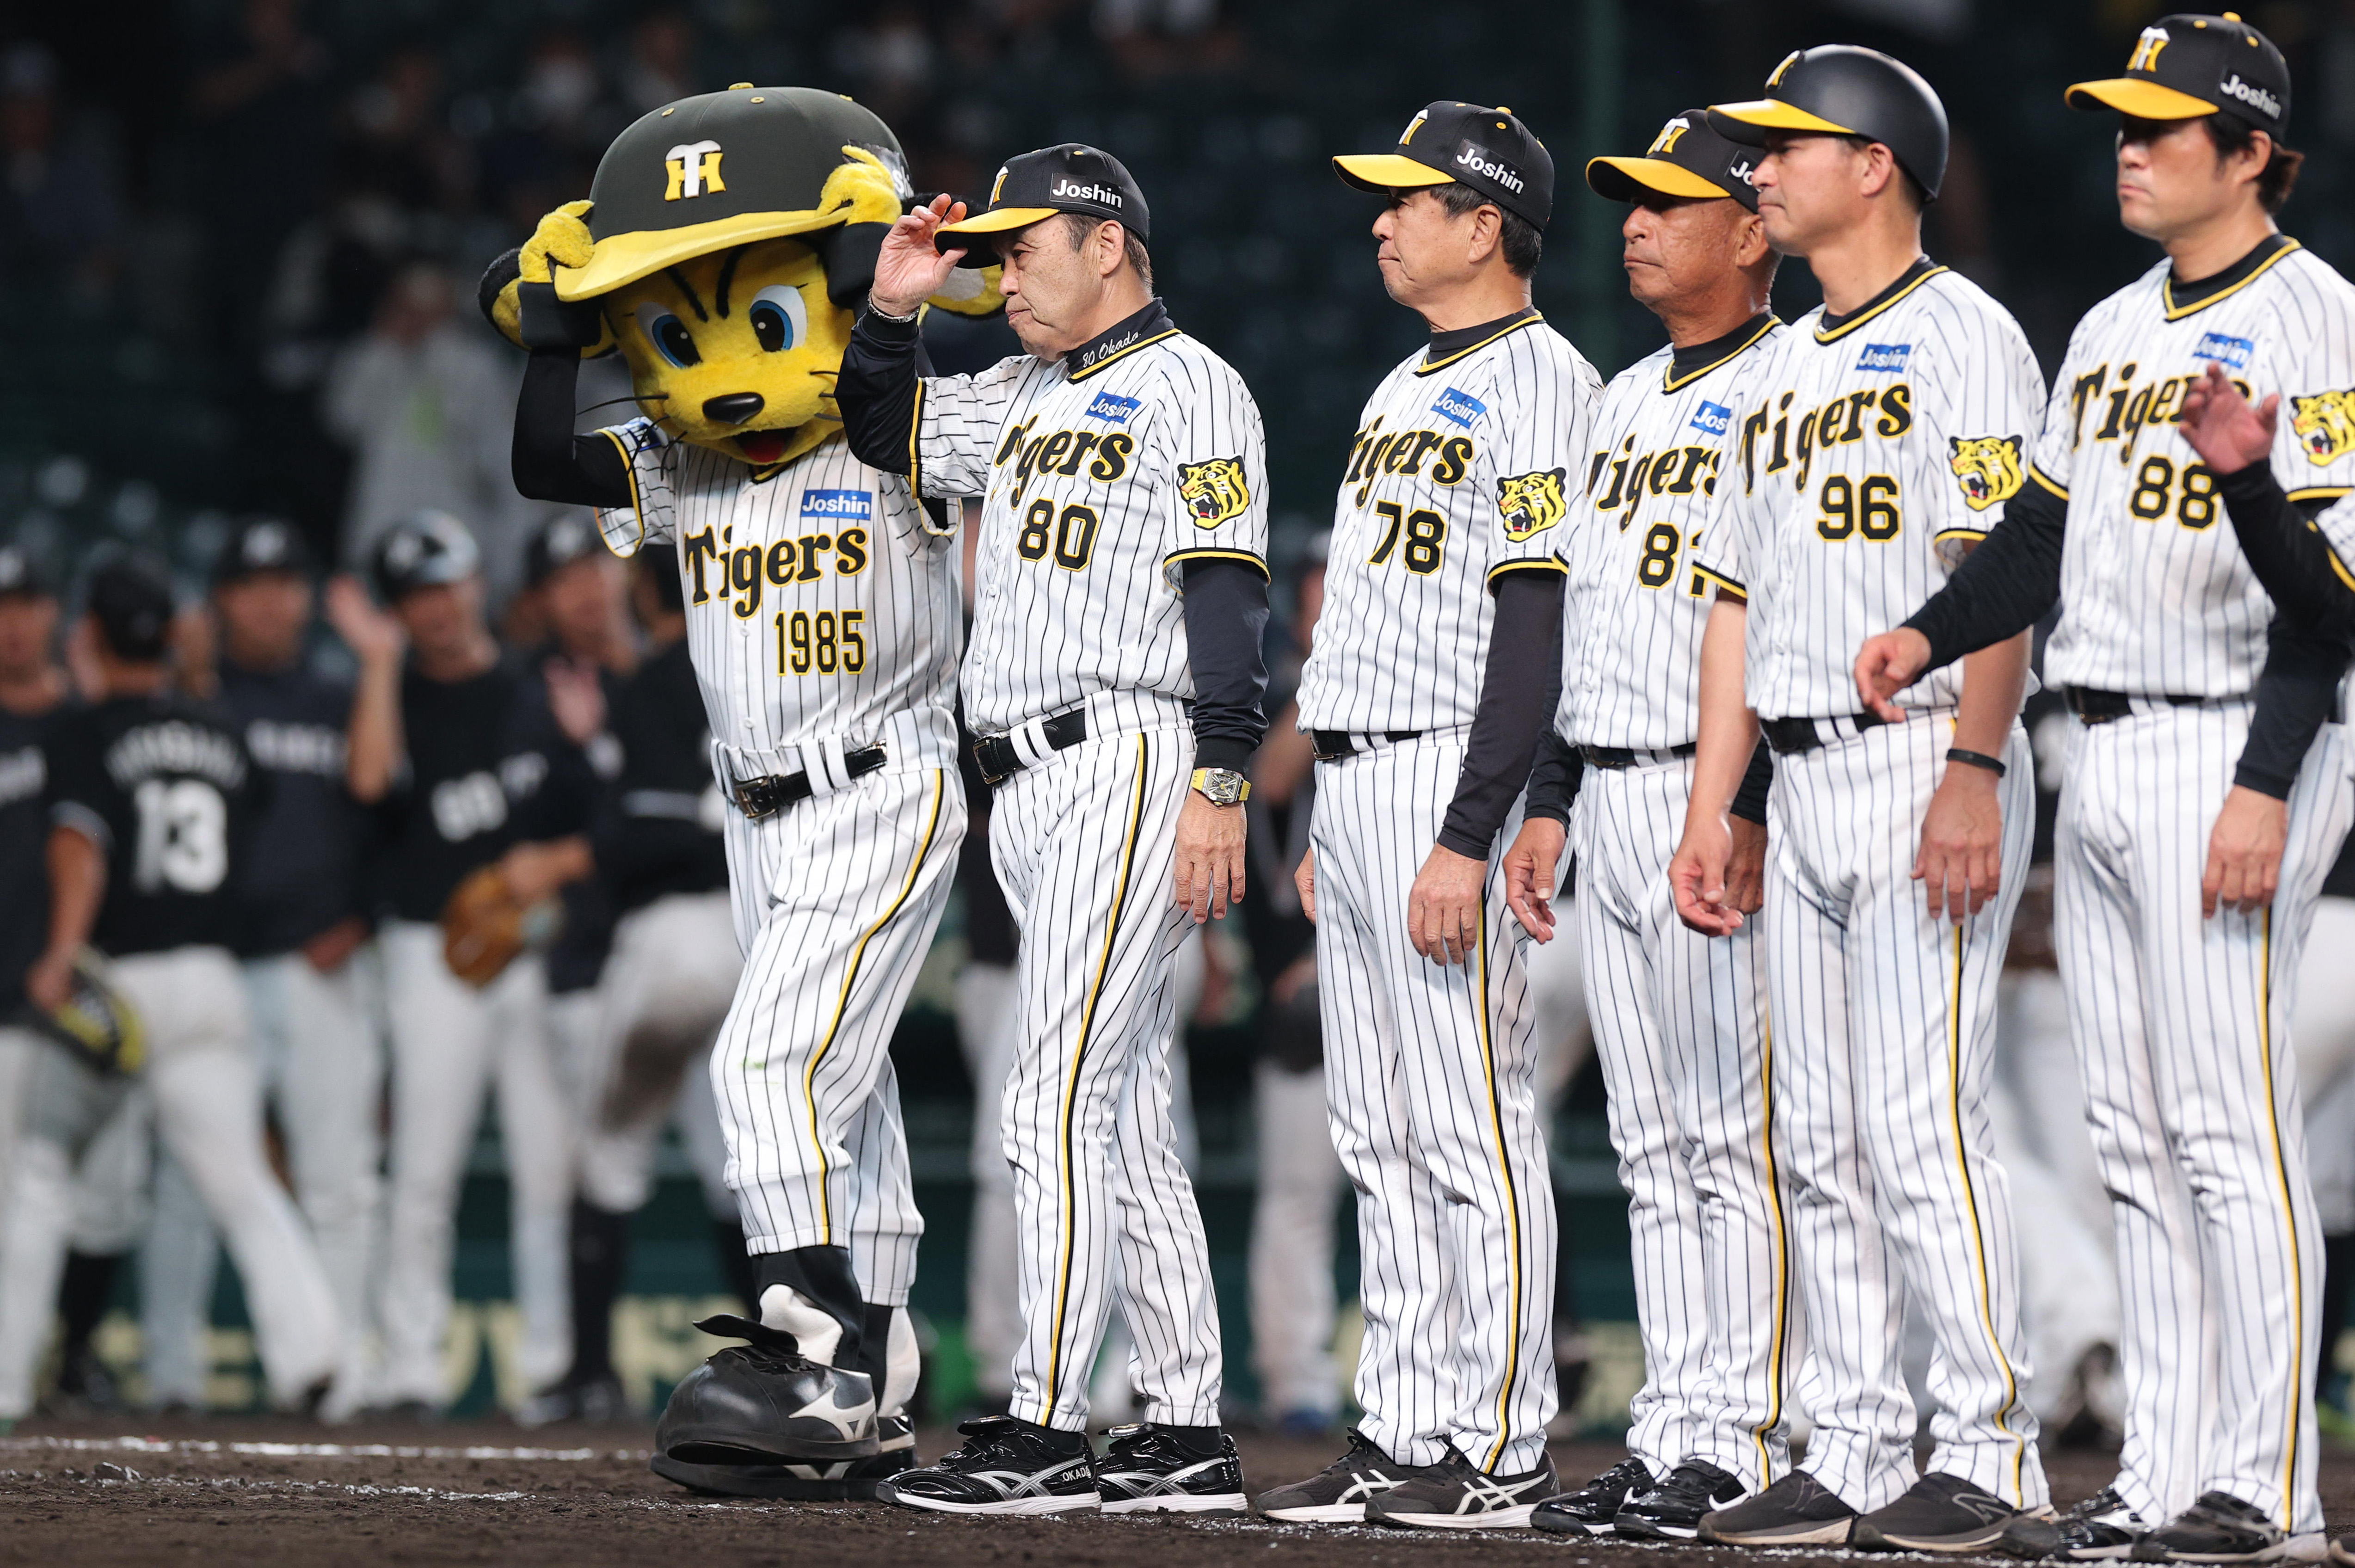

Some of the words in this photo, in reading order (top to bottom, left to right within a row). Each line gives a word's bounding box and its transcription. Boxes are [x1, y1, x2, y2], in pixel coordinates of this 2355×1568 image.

[2220, 74, 2281, 119] Joshin
[1052, 179, 1123, 209] Joshin
[1457, 148, 1525, 194] Joshin
[1082, 350, 1095, 368] 80
[1737, 382, 1913, 498] Tigers
[2072, 362, 2252, 467] Tige
[801, 494, 870, 515] Joshin
[1816, 473, 1902, 543] 96
[2130, 452, 2220, 531] 88
[1016, 496, 1100, 572] 80
[1365, 499, 1447, 576] 78
[683, 523, 869, 621] Tigers
[774, 609, 867, 677] 1985
[133, 781, 228, 894] 13
[1062, 1465, 1092, 1482] OKADA
